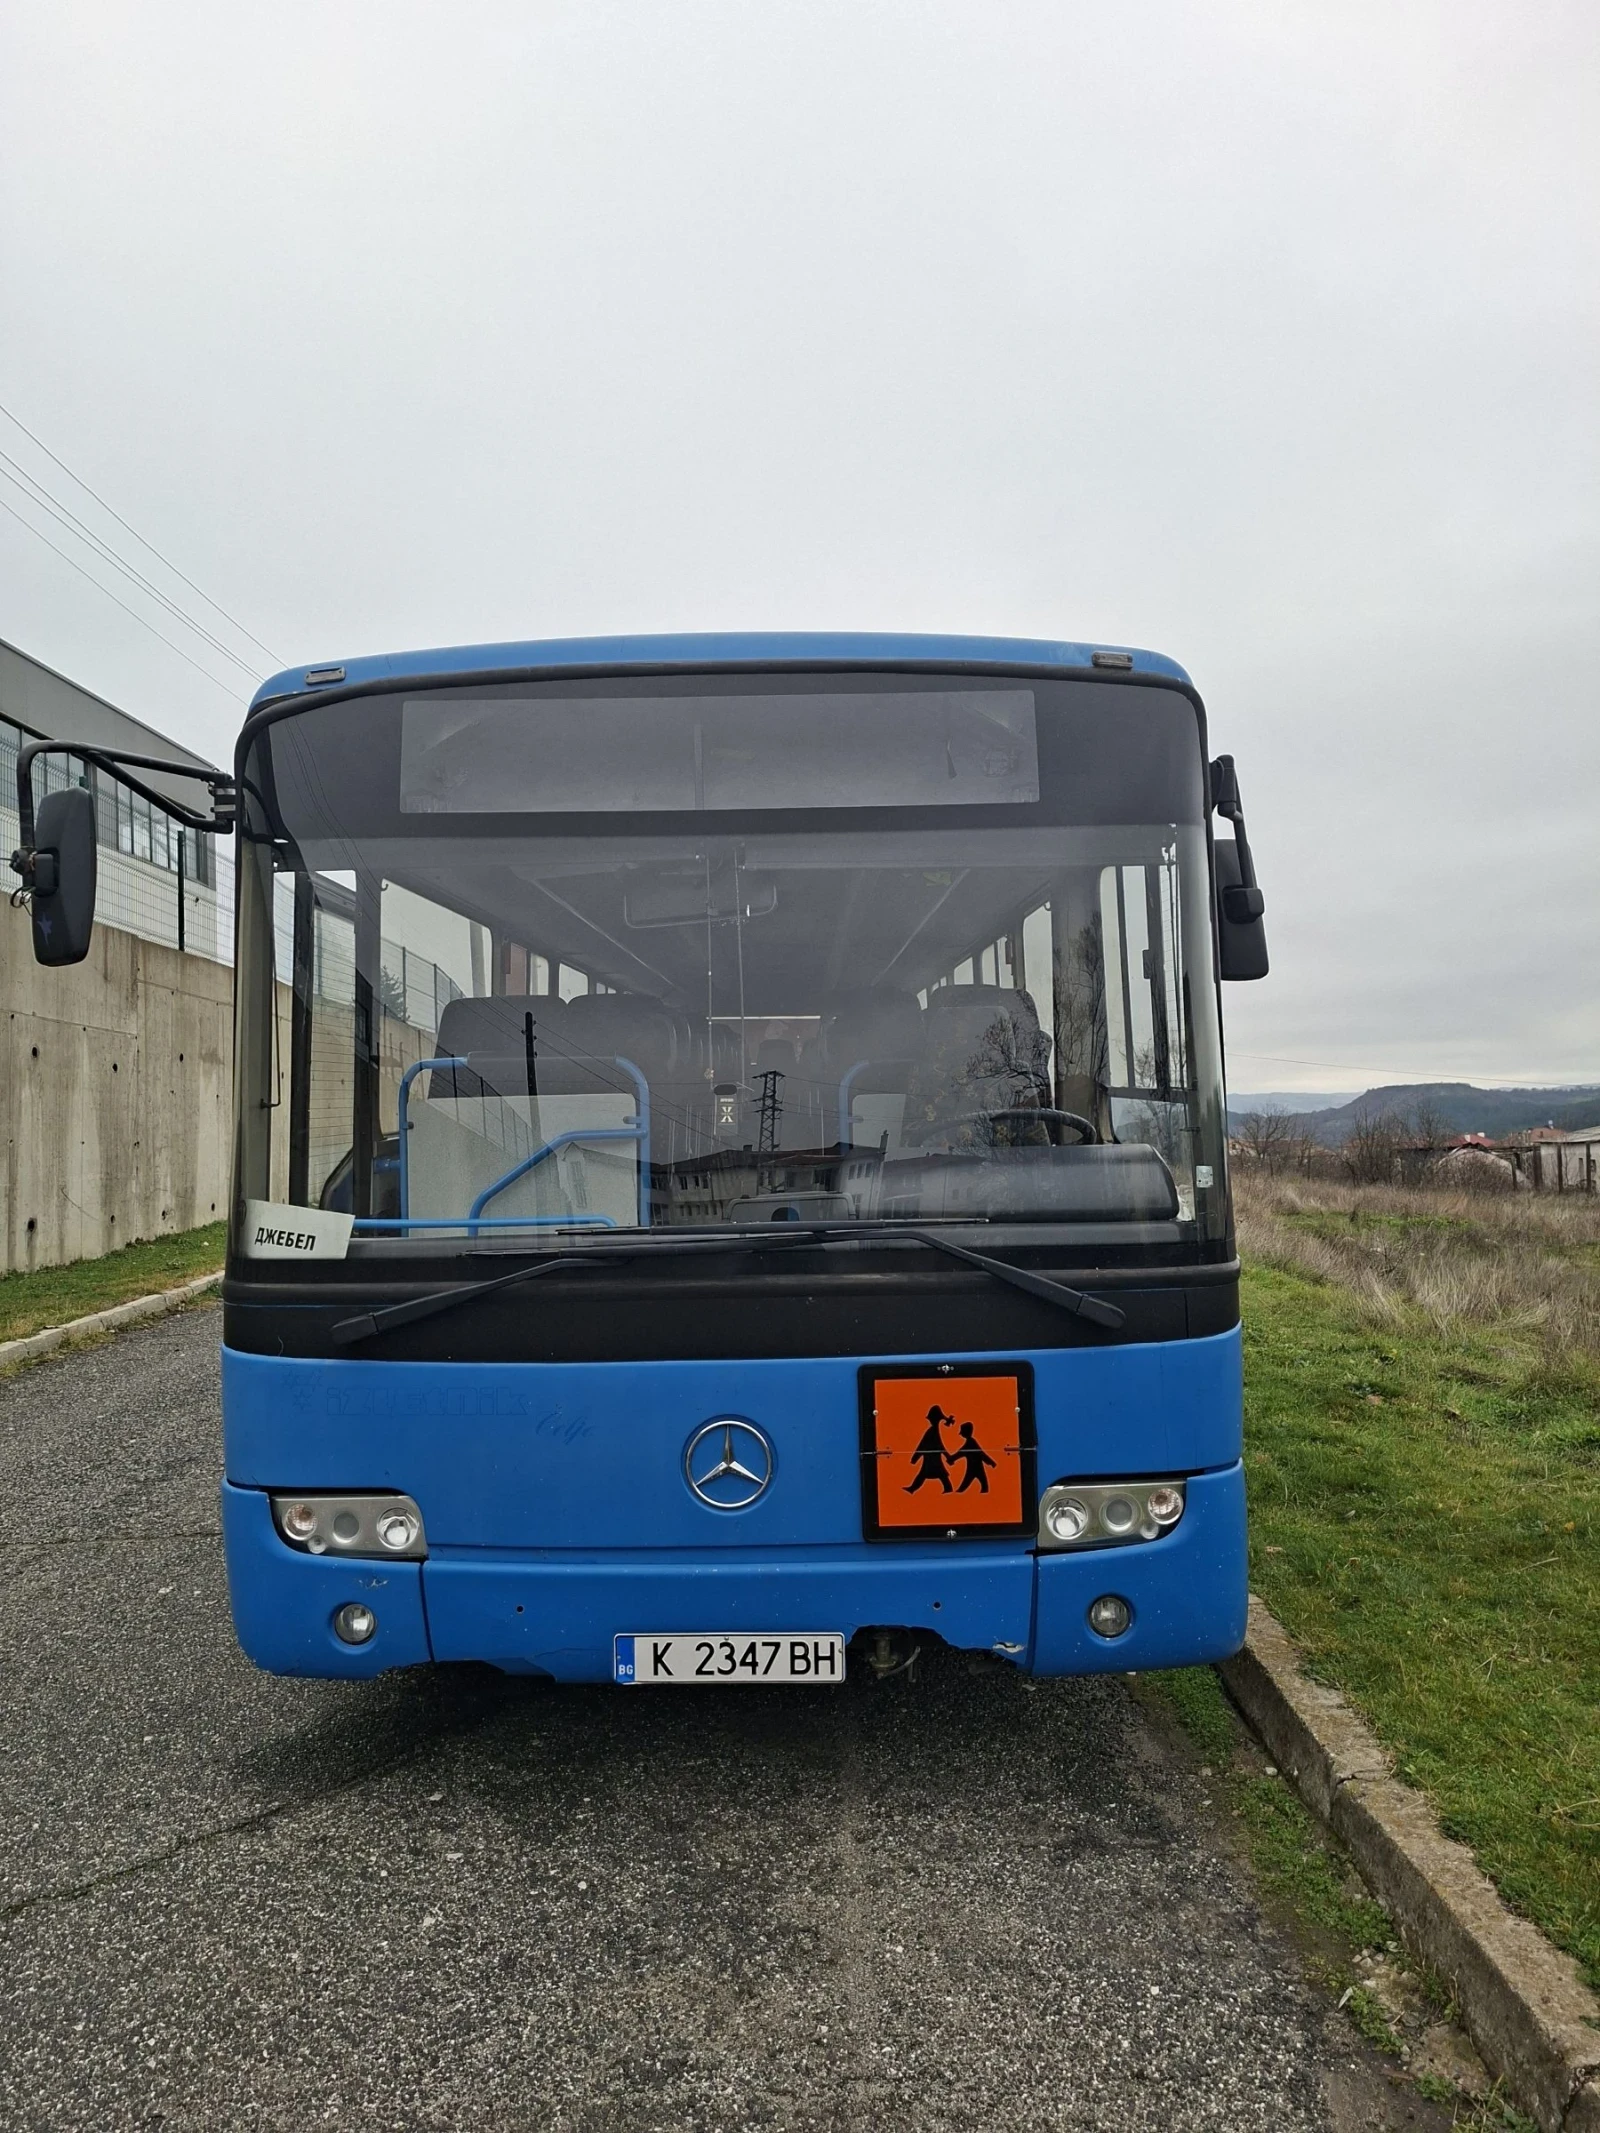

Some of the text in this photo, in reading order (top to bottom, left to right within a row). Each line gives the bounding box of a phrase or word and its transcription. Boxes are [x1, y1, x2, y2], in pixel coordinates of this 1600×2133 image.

[254, 1227, 317, 1251] ДЖЕБЕЛ
[618, 1664, 634, 1675] BG
[652, 1642, 674, 1676] K
